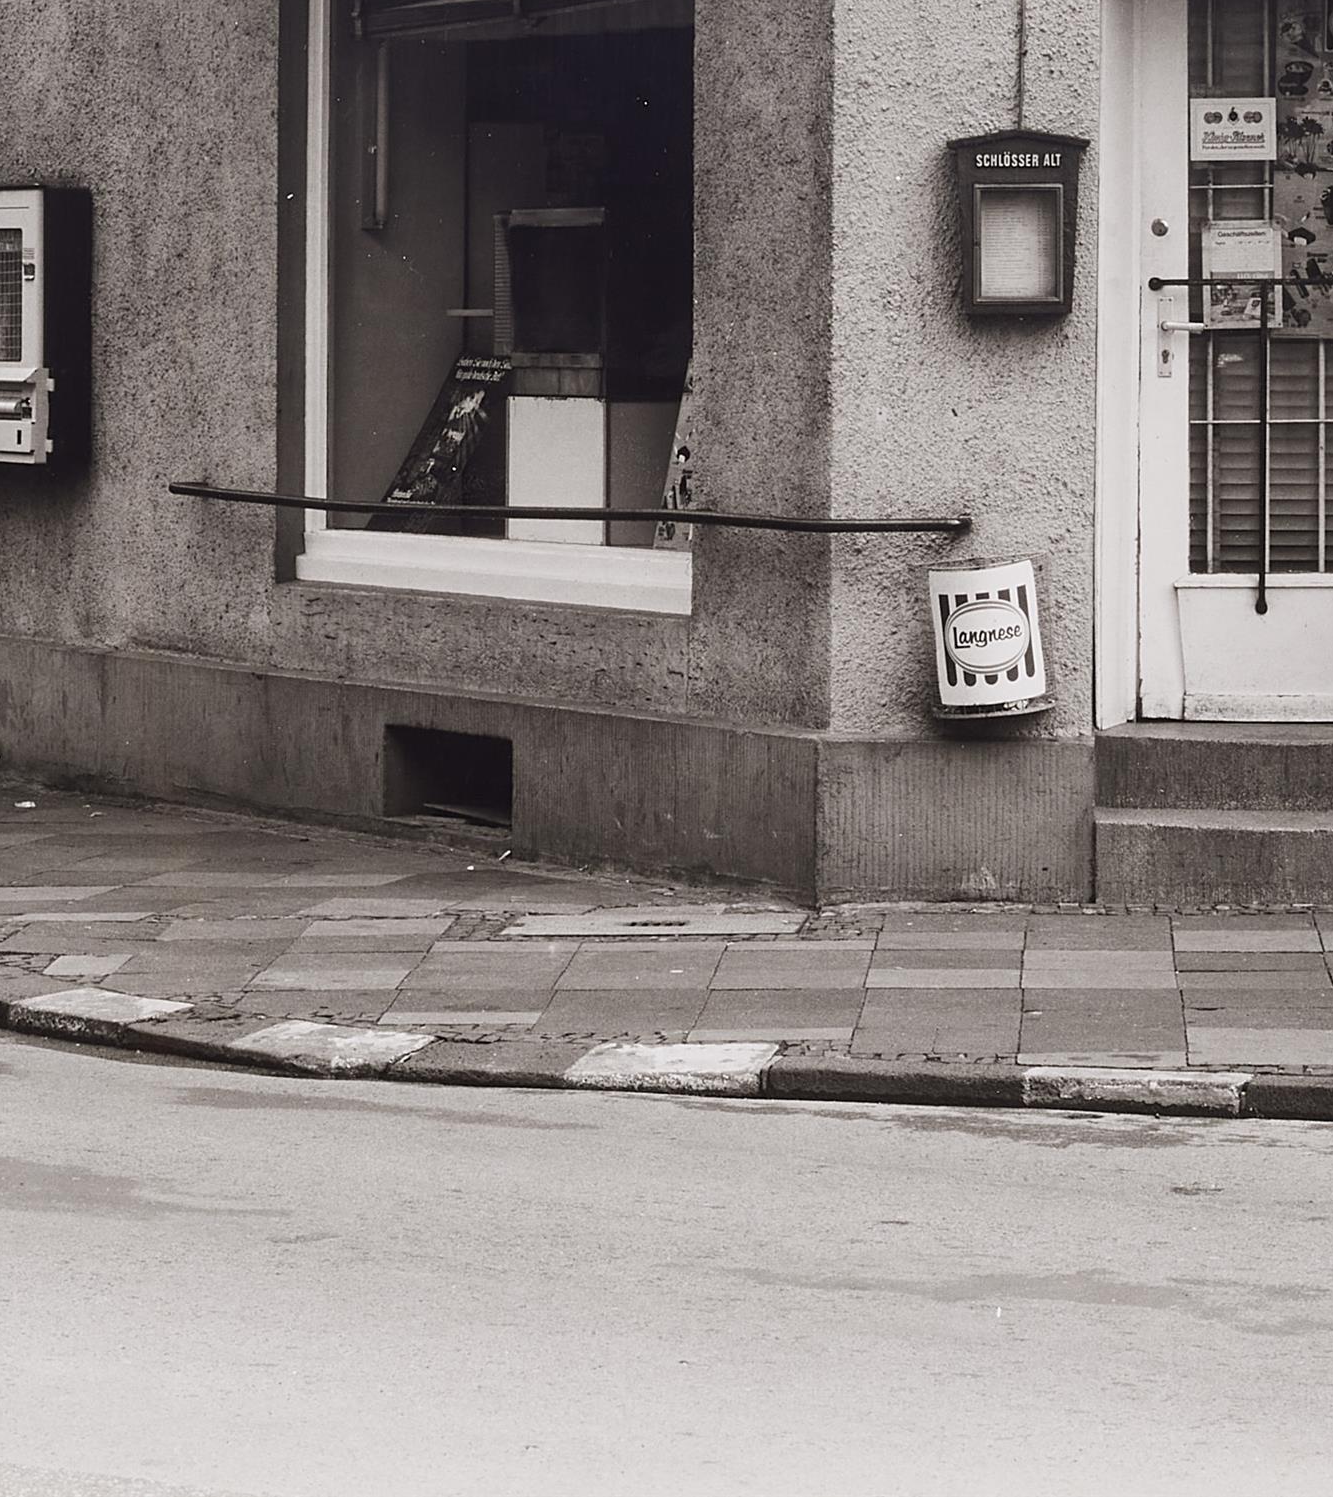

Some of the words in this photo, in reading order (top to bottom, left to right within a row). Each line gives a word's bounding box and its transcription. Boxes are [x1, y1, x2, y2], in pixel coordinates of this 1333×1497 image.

[975, 151, 1040, 168] SCHLÖSSER
[1043, 153, 1062, 168] ALT
[952, 622, 1023, 650] Langnese
